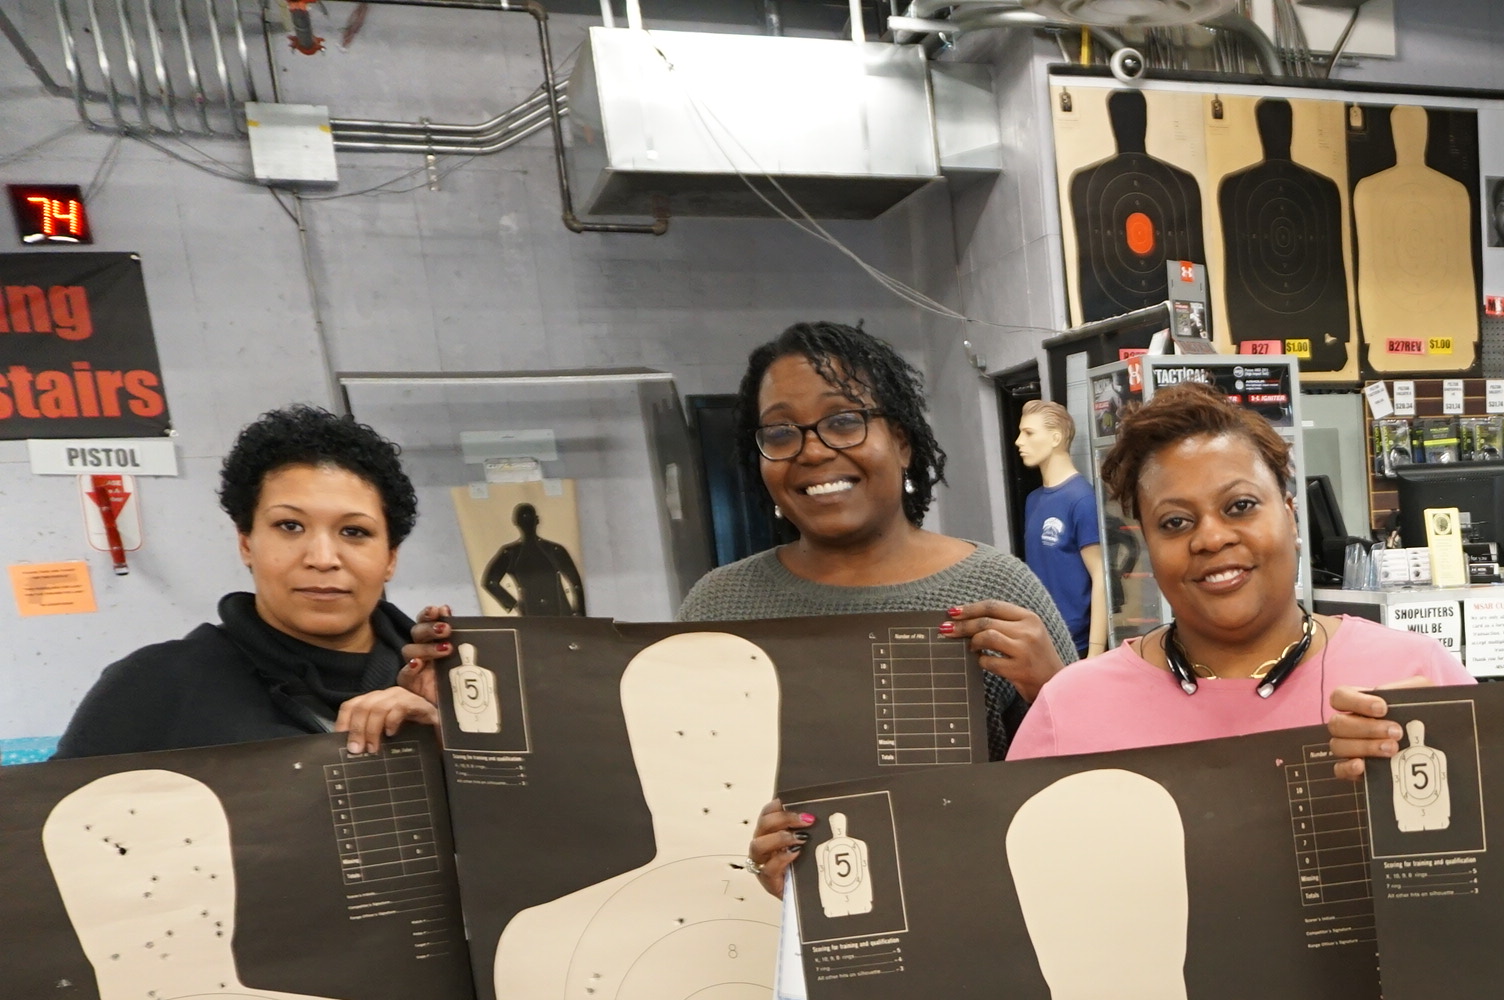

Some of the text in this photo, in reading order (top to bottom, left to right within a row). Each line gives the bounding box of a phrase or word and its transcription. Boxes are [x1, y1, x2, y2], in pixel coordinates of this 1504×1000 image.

[27, 196, 80, 234] 74
[1252, 343, 1269, 354] B27
[1286, 341, 1308, 353] $1.00
[1388, 340, 1422, 352] B27REV
[1429, 338, 1451, 351] $1.00
[66, 447, 140, 468] PISTOL
[1395, 607, 1454, 620] SHOPLIFTERS
[1408, 623, 1442, 634] WILL BE
[464, 679, 479, 700] 5
[1411, 763, 1429, 790] 5
[835, 853, 851, 877] 5
[1384, 861, 1402, 869] Scoring
[1445, 857, 1476, 865] qualification
[840, 942, 858, 950] training
[870, 938, 899, 947] qualification
[727, 943, 739, 959] 8
